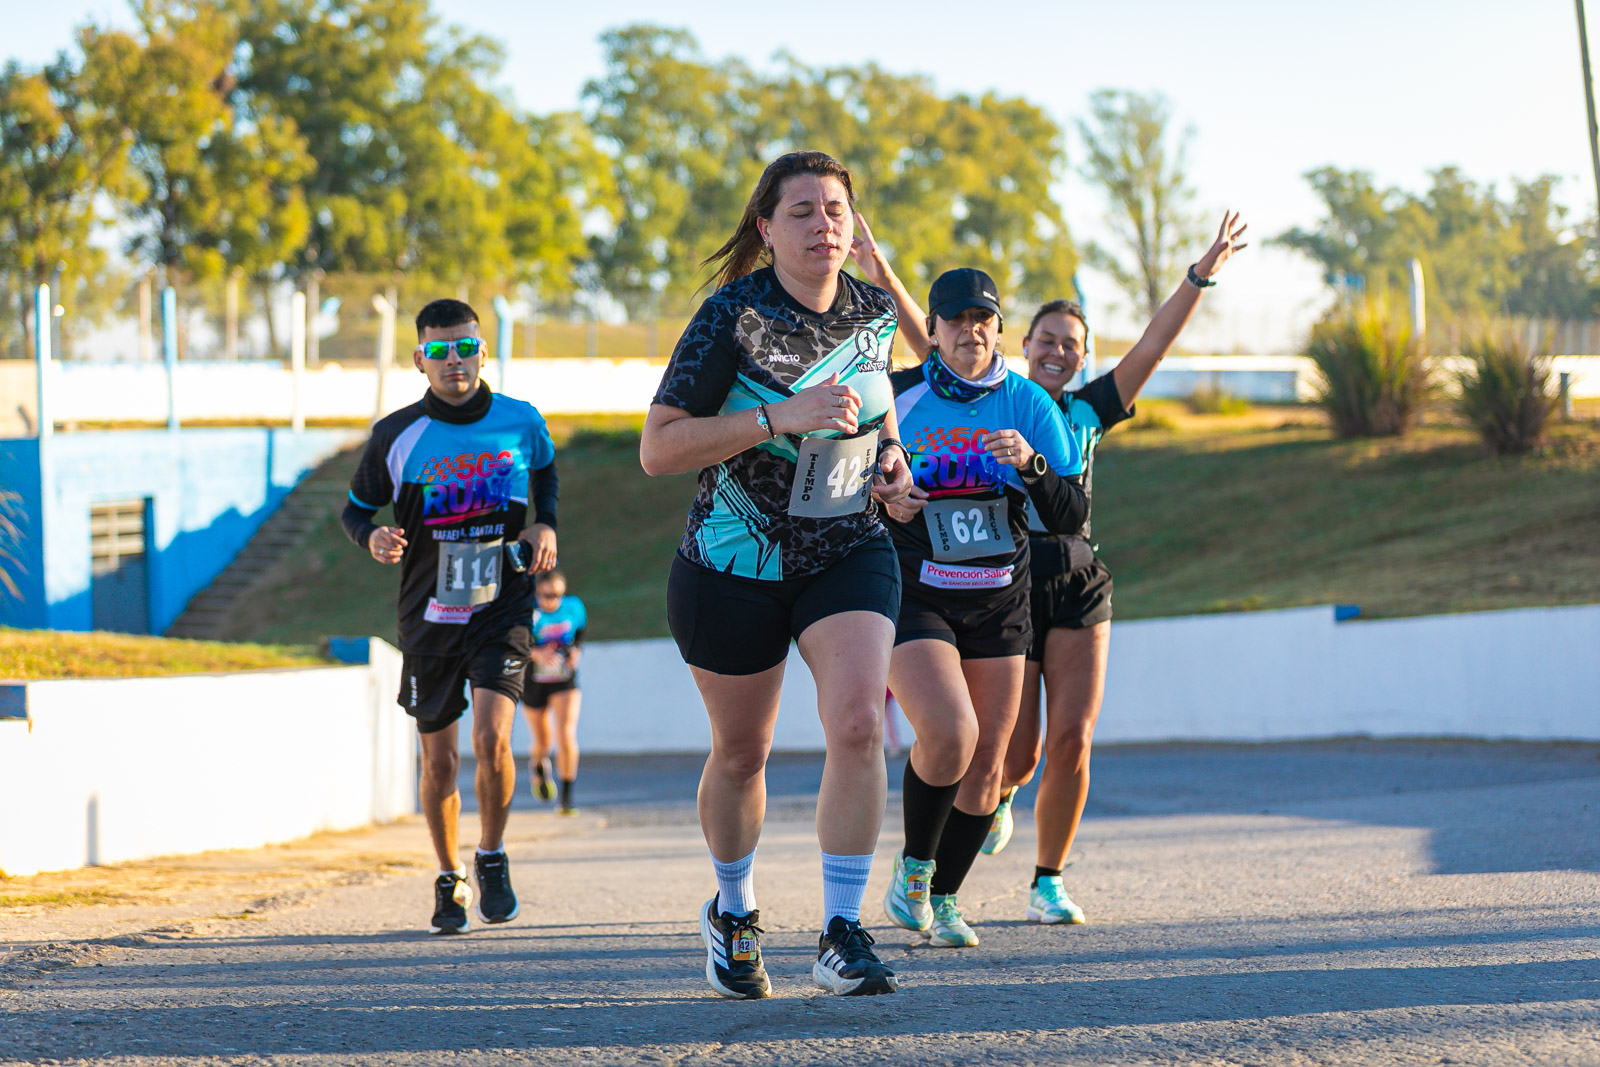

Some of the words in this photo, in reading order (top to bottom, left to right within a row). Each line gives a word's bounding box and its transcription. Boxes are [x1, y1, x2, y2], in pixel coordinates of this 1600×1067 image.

[769, 354, 800, 363] INVICTO
[856, 362, 873, 373] KM
[949, 427, 995, 454] 50
[801, 453, 818, 501] TIEMPO
[827, 456, 861, 498] 42
[910, 453, 998, 488] RUN
[423, 478, 505, 515] RUN
[469, 525, 494, 537] SANTA
[494, 523, 505, 535] FE
[935, 512, 950, 551] TIEMPO
[951, 508, 988, 544] 62
[453, 556, 497, 590] 114
[927, 564, 982, 580] Prevención
[429, 601, 475, 614] Prevenció
[913, 882, 923, 890] 62
[740, 940, 750, 951] 42
